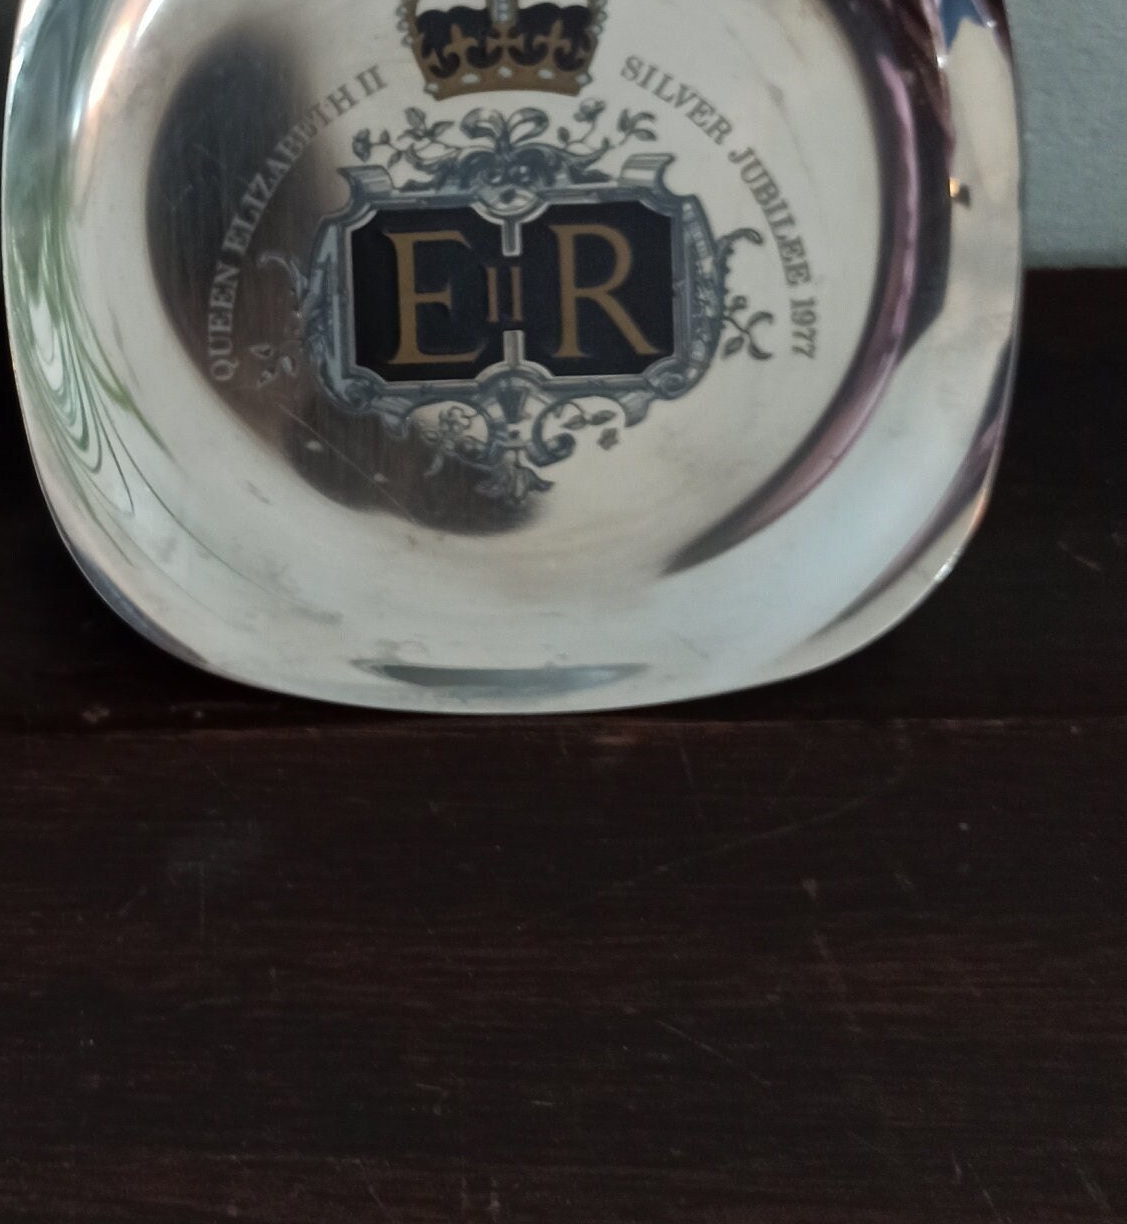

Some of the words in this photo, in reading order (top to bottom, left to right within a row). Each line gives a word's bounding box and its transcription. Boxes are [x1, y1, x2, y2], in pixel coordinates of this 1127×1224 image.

[356, 65, 388, 96] II
[621, 55, 732, 146] SILVER
[222, 84, 359, 256] ELIZABETH
[728, 147, 812, 286] JUBILEE
[208, 259, 240, 381] QUEEN
[790, 296, 819, 359] 1977
